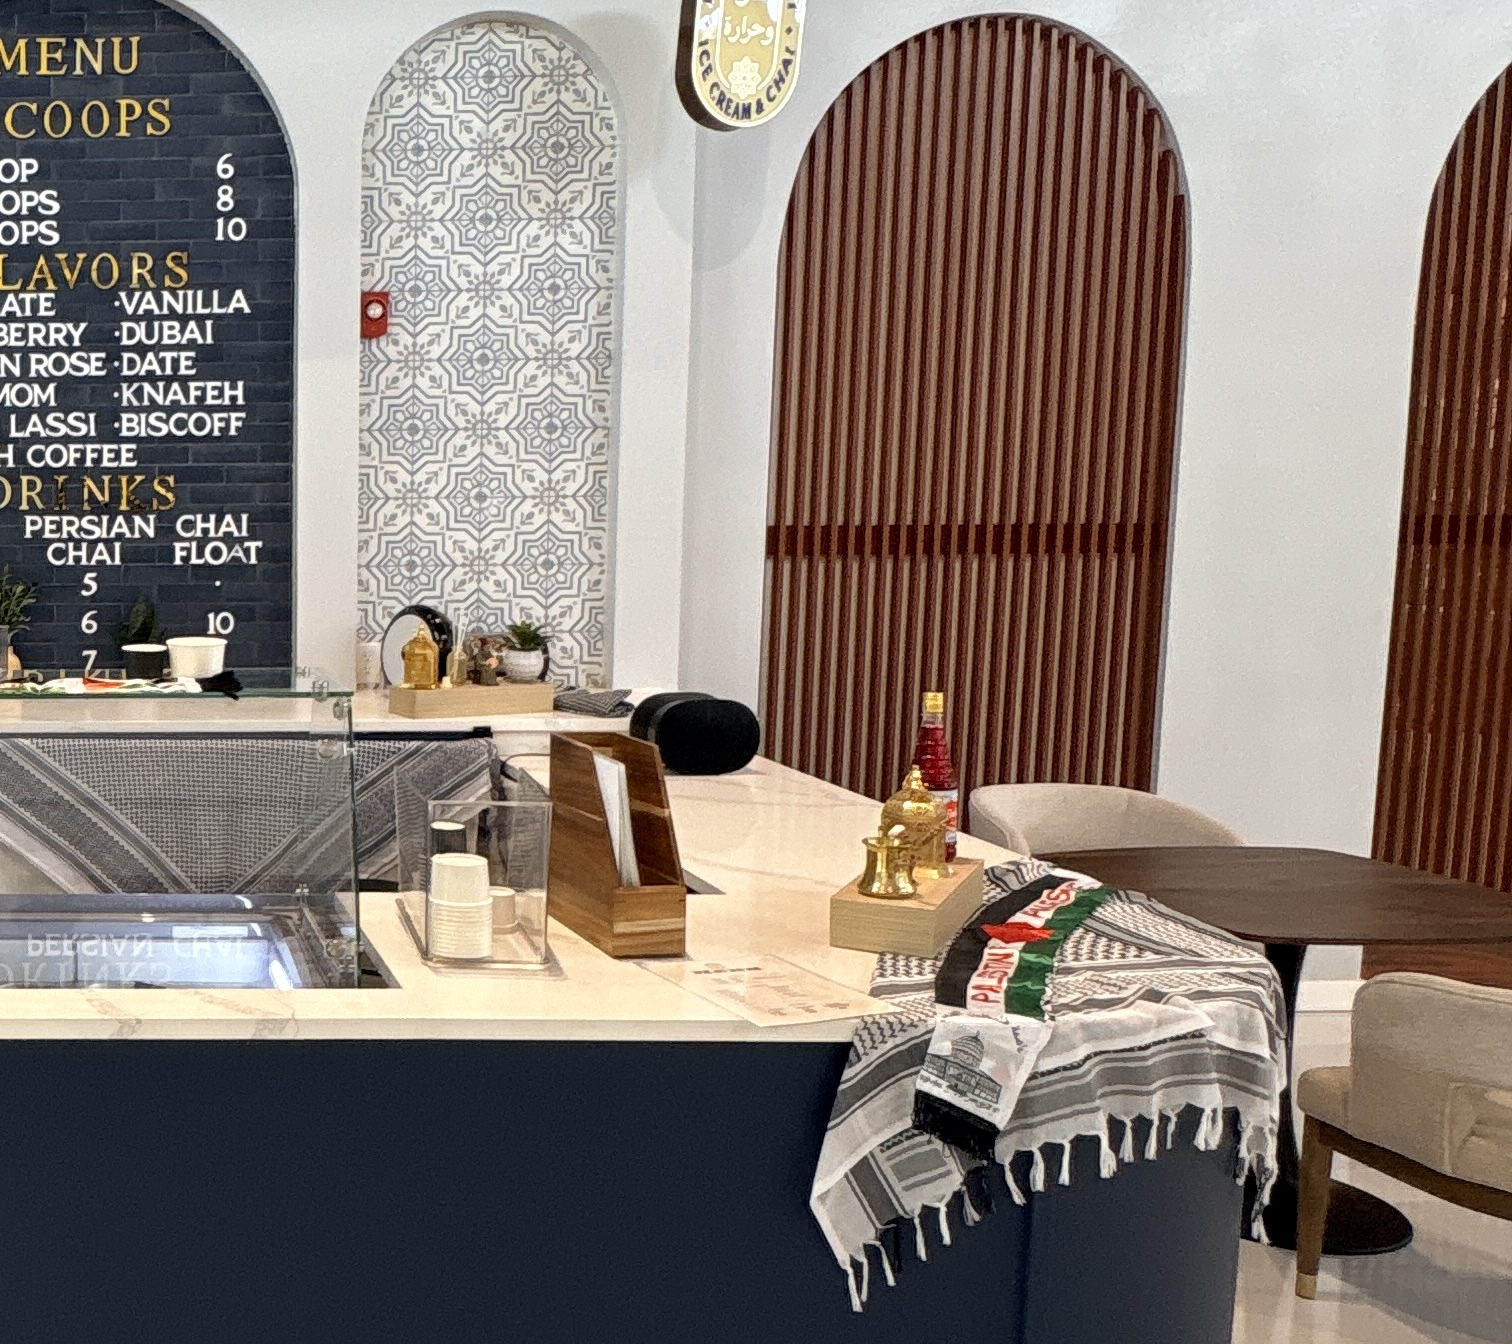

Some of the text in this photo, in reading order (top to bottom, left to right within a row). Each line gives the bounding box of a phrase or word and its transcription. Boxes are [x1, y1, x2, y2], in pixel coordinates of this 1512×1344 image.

[698, 39, 796, 120] ICE CREAM & CHAI
[216, 152, 235, 180] 6
[216, 184, 235, 212] 8
[215, 216, 247, 242] 10
[119, 288, 252, 316] VANILLA
[119, 319, 214, 346] DUBAI
[28, 351, 107, 378] ROSE
[120, 351, 197, 376] DATE
[120, 380, 246, 407] KNAFEH
[8, 411, 97, 438] LASSI
[119, 411, 247, 437] BISCOFF
[26, 443, 138, 468] COFFEE
[23, 513, 157, 540] PERSIAN
[175, 513, 249, 538] CHAI
[46, 541, 122, 566] CHAI
[172, 540, 263, 566] FLOAT
[80, 572, 98, 597] 5
[80, 610, 98, 634] 6
[206, 611, 235, 635] 10
[81, 649, 99, 674] 7
